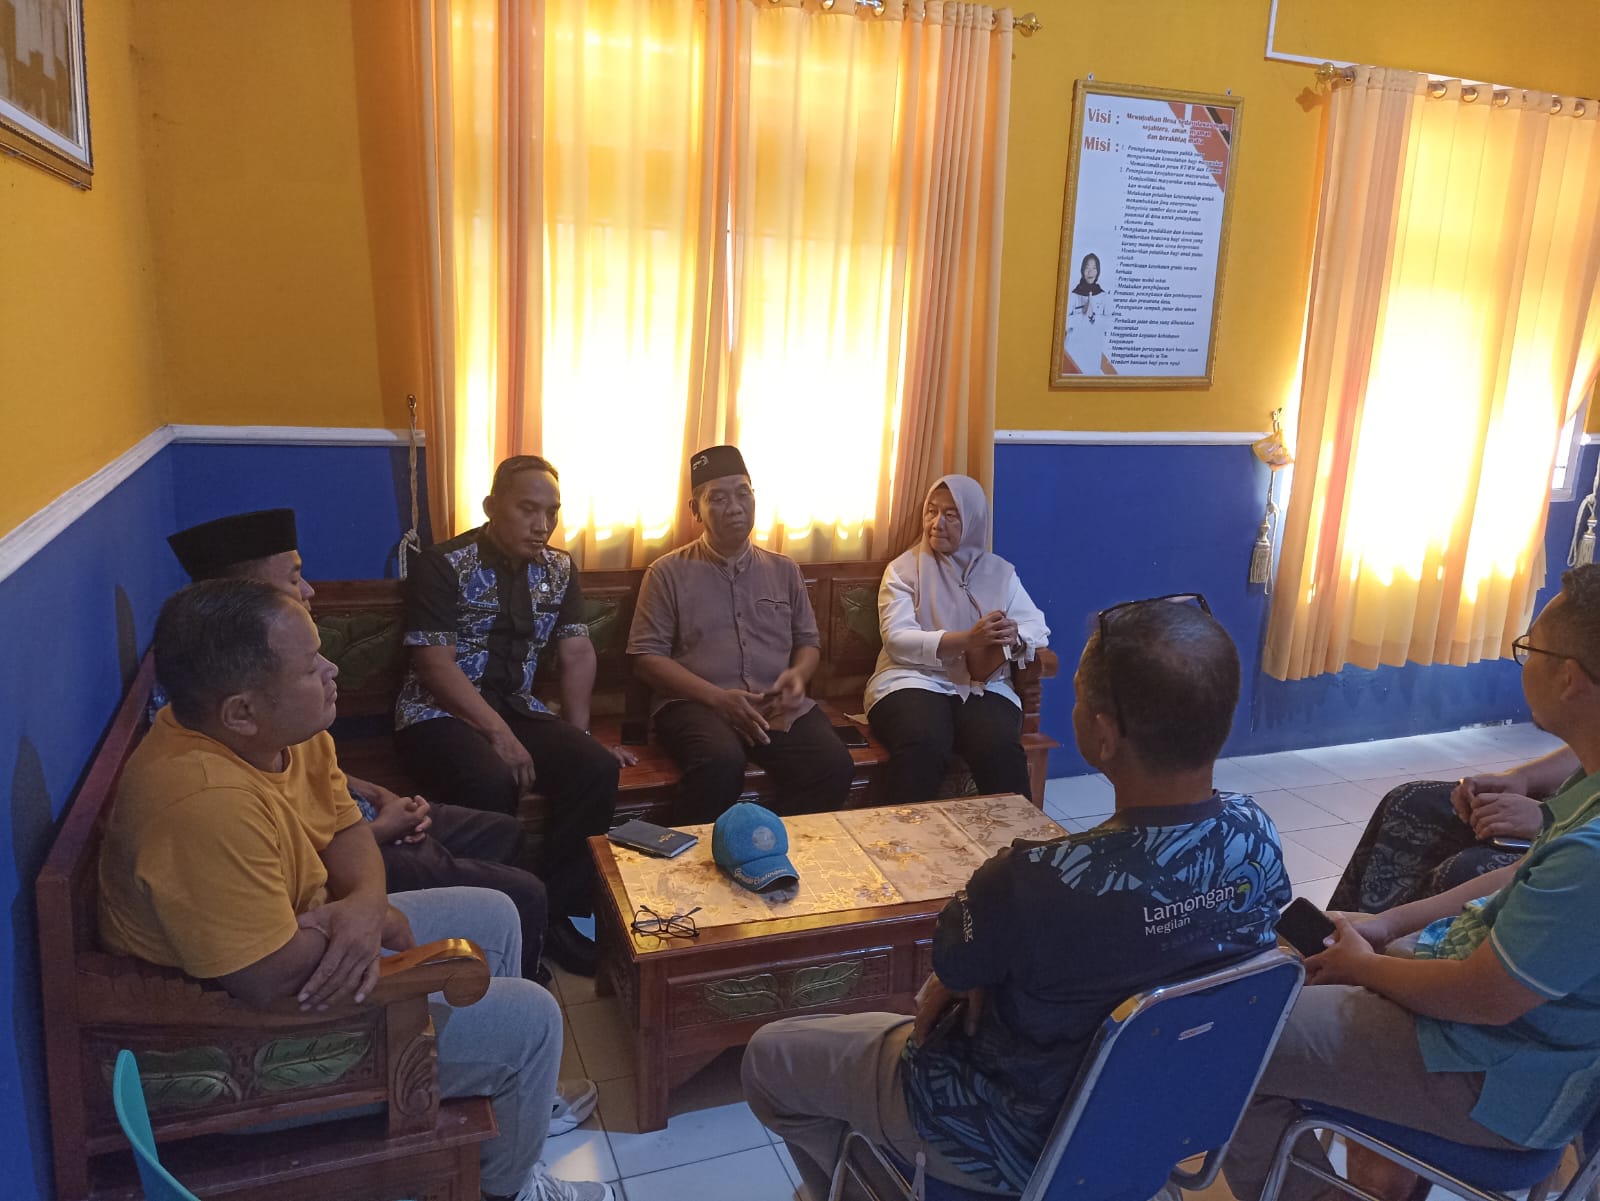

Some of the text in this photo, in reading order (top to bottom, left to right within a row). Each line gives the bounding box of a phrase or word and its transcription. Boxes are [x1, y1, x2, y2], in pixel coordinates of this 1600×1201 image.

[1087, 108, 1112, 124] Visi
[1084, 136, 1111, 152] Misi
[1143, 886, 1235, 923] Lamongan
